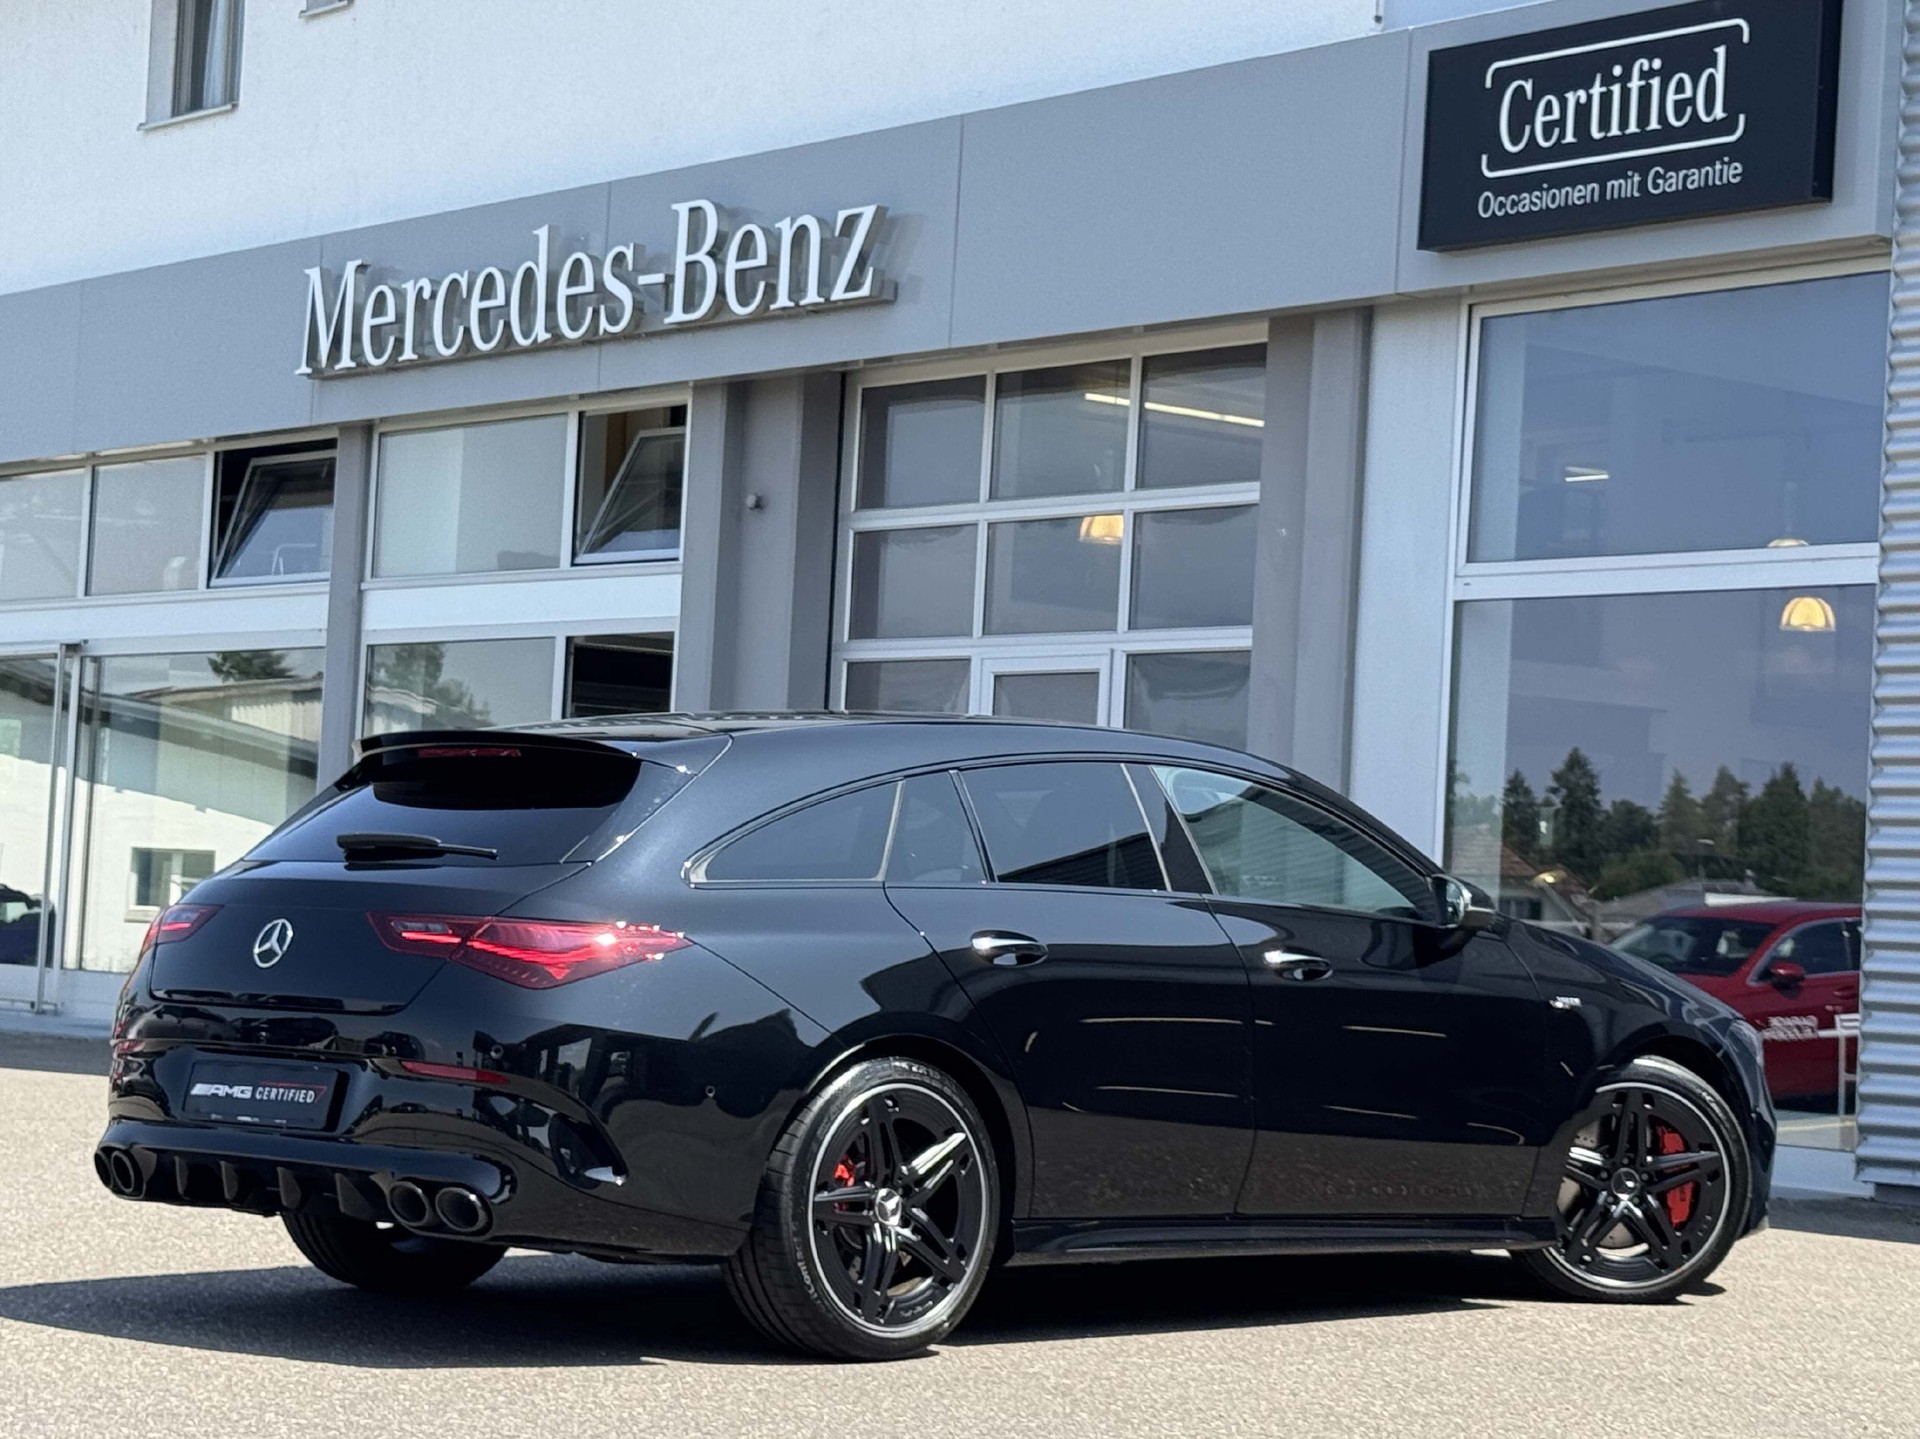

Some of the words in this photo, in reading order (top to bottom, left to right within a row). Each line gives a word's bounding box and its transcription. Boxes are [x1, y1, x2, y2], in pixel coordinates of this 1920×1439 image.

[1499, 44, 1728, 154] Certified
[1477, 179, 1600, 219] Occasionen
[1605, 170, 1642, 201] mit
[1647, 156, 1744, 196] Garantie
[294, 198, 888, 376] Mercedes-Benz
[207, 1084, 253, 1099] AMG
[255, 1086, 316, 1104] CERTIFIED
